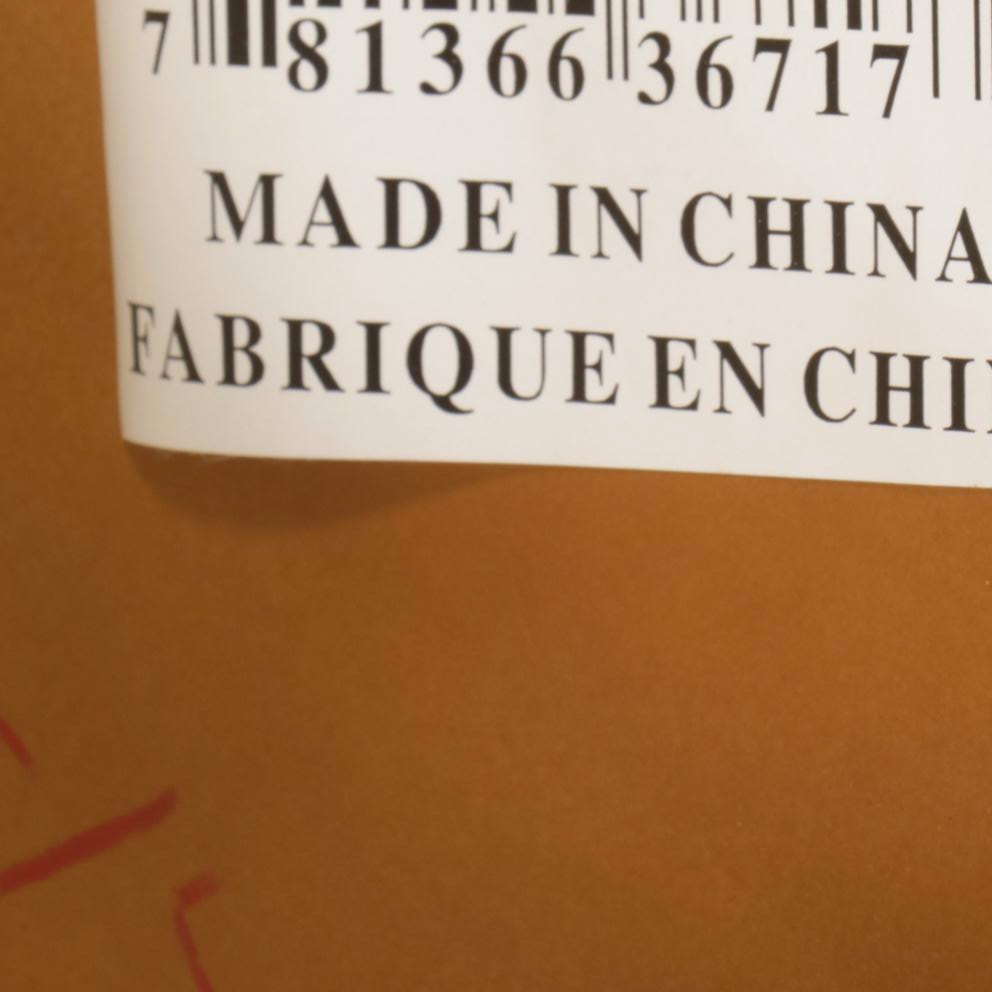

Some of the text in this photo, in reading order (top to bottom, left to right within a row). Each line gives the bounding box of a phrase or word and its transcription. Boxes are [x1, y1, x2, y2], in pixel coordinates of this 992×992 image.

[142, 9, 171, 76] 7
[286, 17, 587, 101] 81366
[636, 30, 911, 120] 36717
[203, 168, 517, 255] MADE
[548, 183, 648, 264] IN
[127, 300, 620, 415] FABRIQUE
[646, 334, 772, 420] EN
